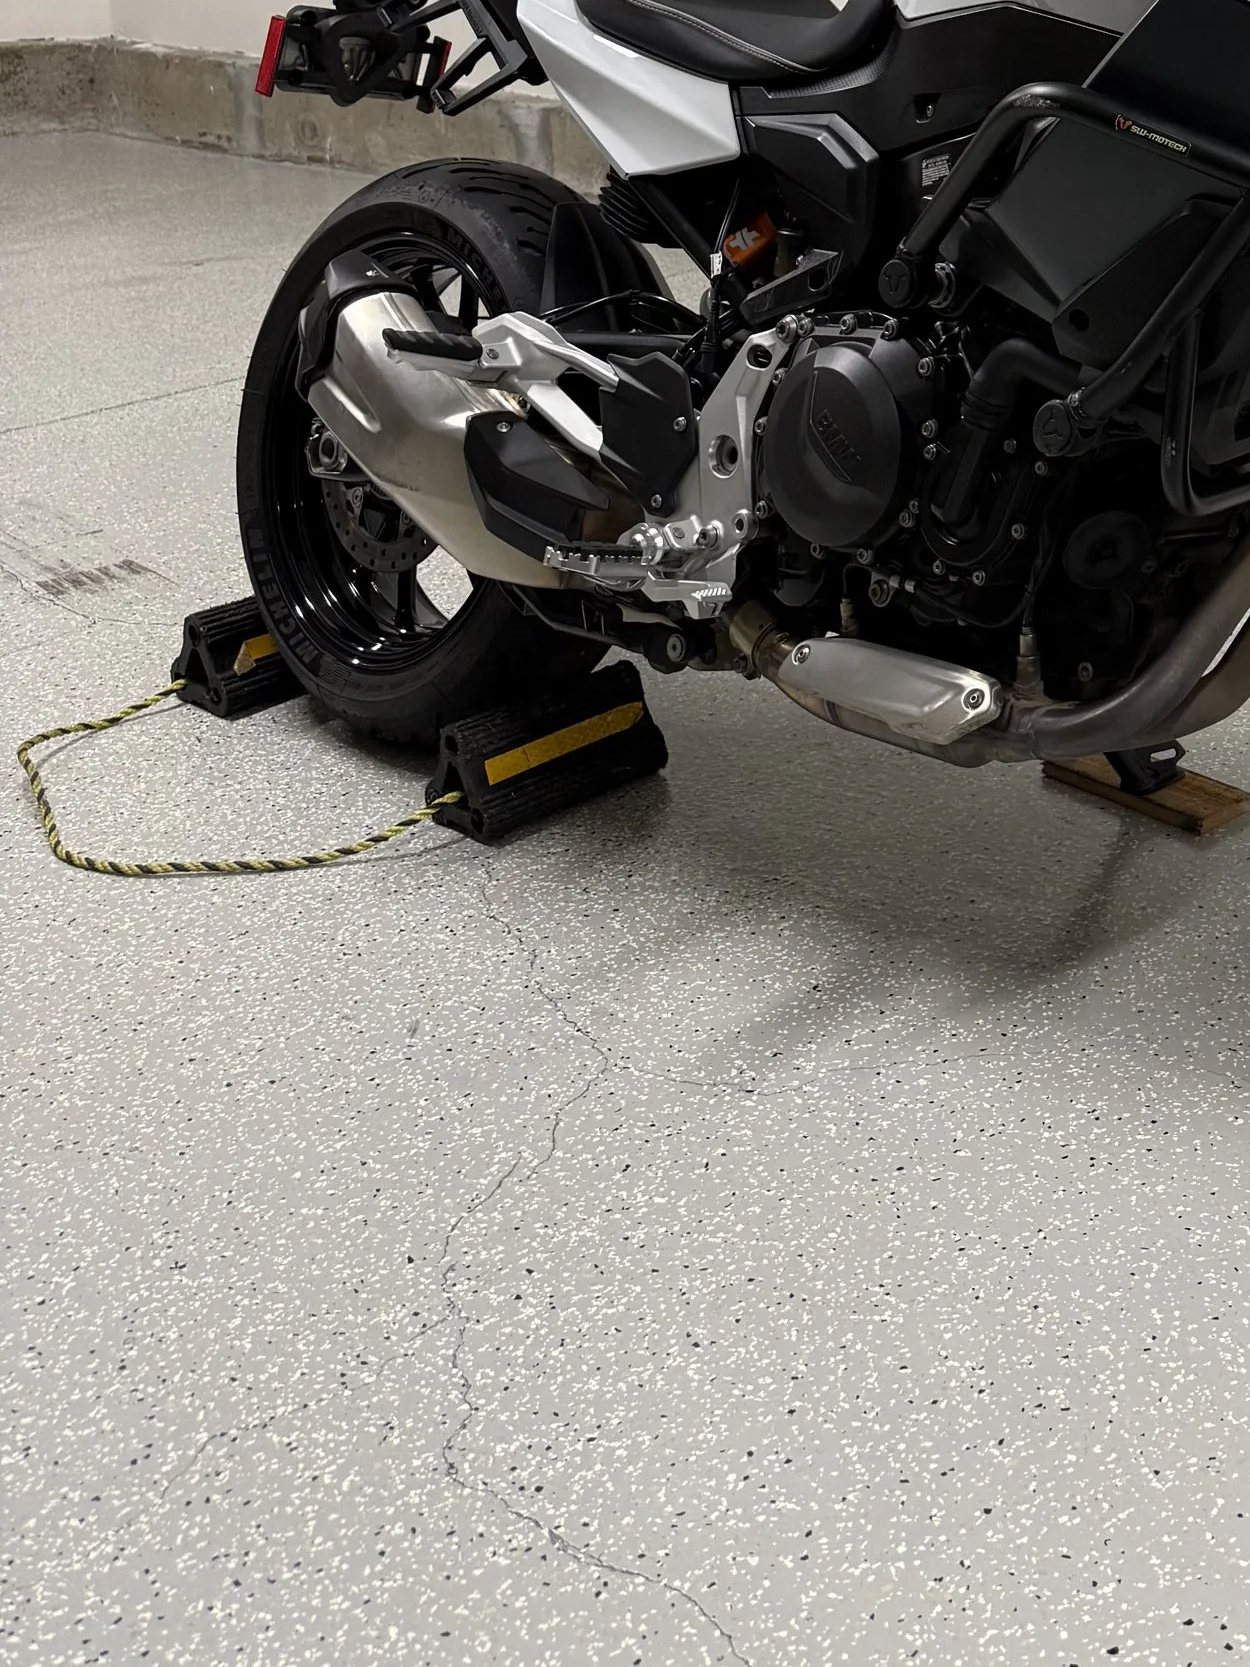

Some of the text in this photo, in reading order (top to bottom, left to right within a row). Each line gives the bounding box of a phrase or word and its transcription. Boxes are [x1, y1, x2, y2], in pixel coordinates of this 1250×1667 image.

[1130, 125, 1187, 153] SW-MOTECH
[447, 226, 508, 310] MICHE
[247, 526, 319, 665] MICHELIN
